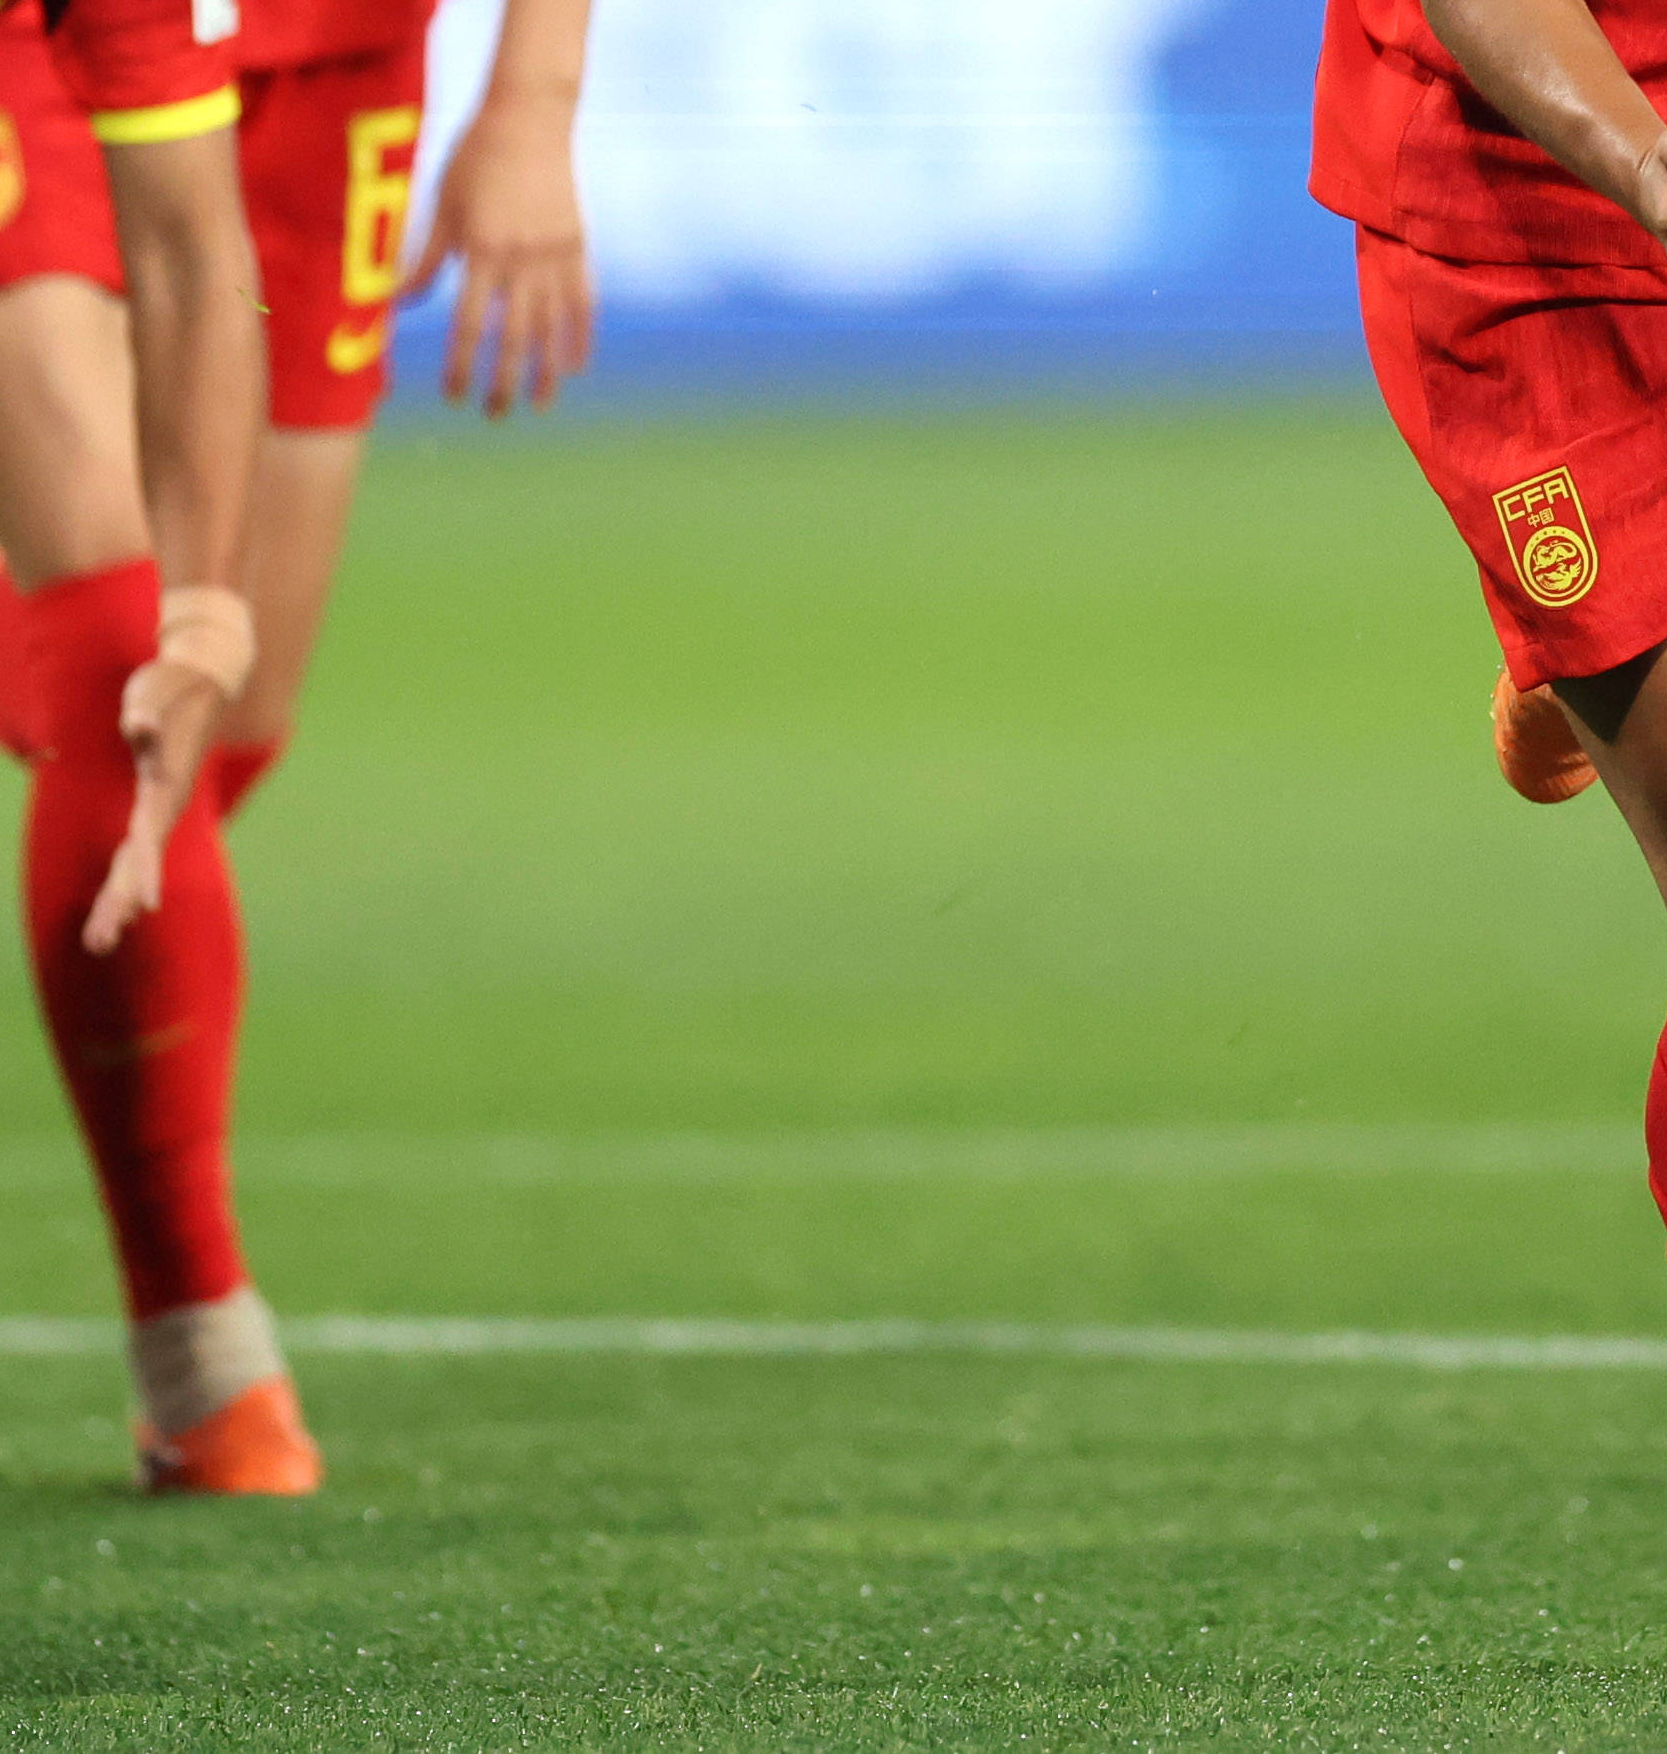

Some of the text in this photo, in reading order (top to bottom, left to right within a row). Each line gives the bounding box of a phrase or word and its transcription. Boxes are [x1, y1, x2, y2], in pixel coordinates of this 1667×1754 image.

[344, 107, 420, 304] 6
[1502, 477, 1569, 522] CFA
[1527, 507, 1554, 528] 中国
